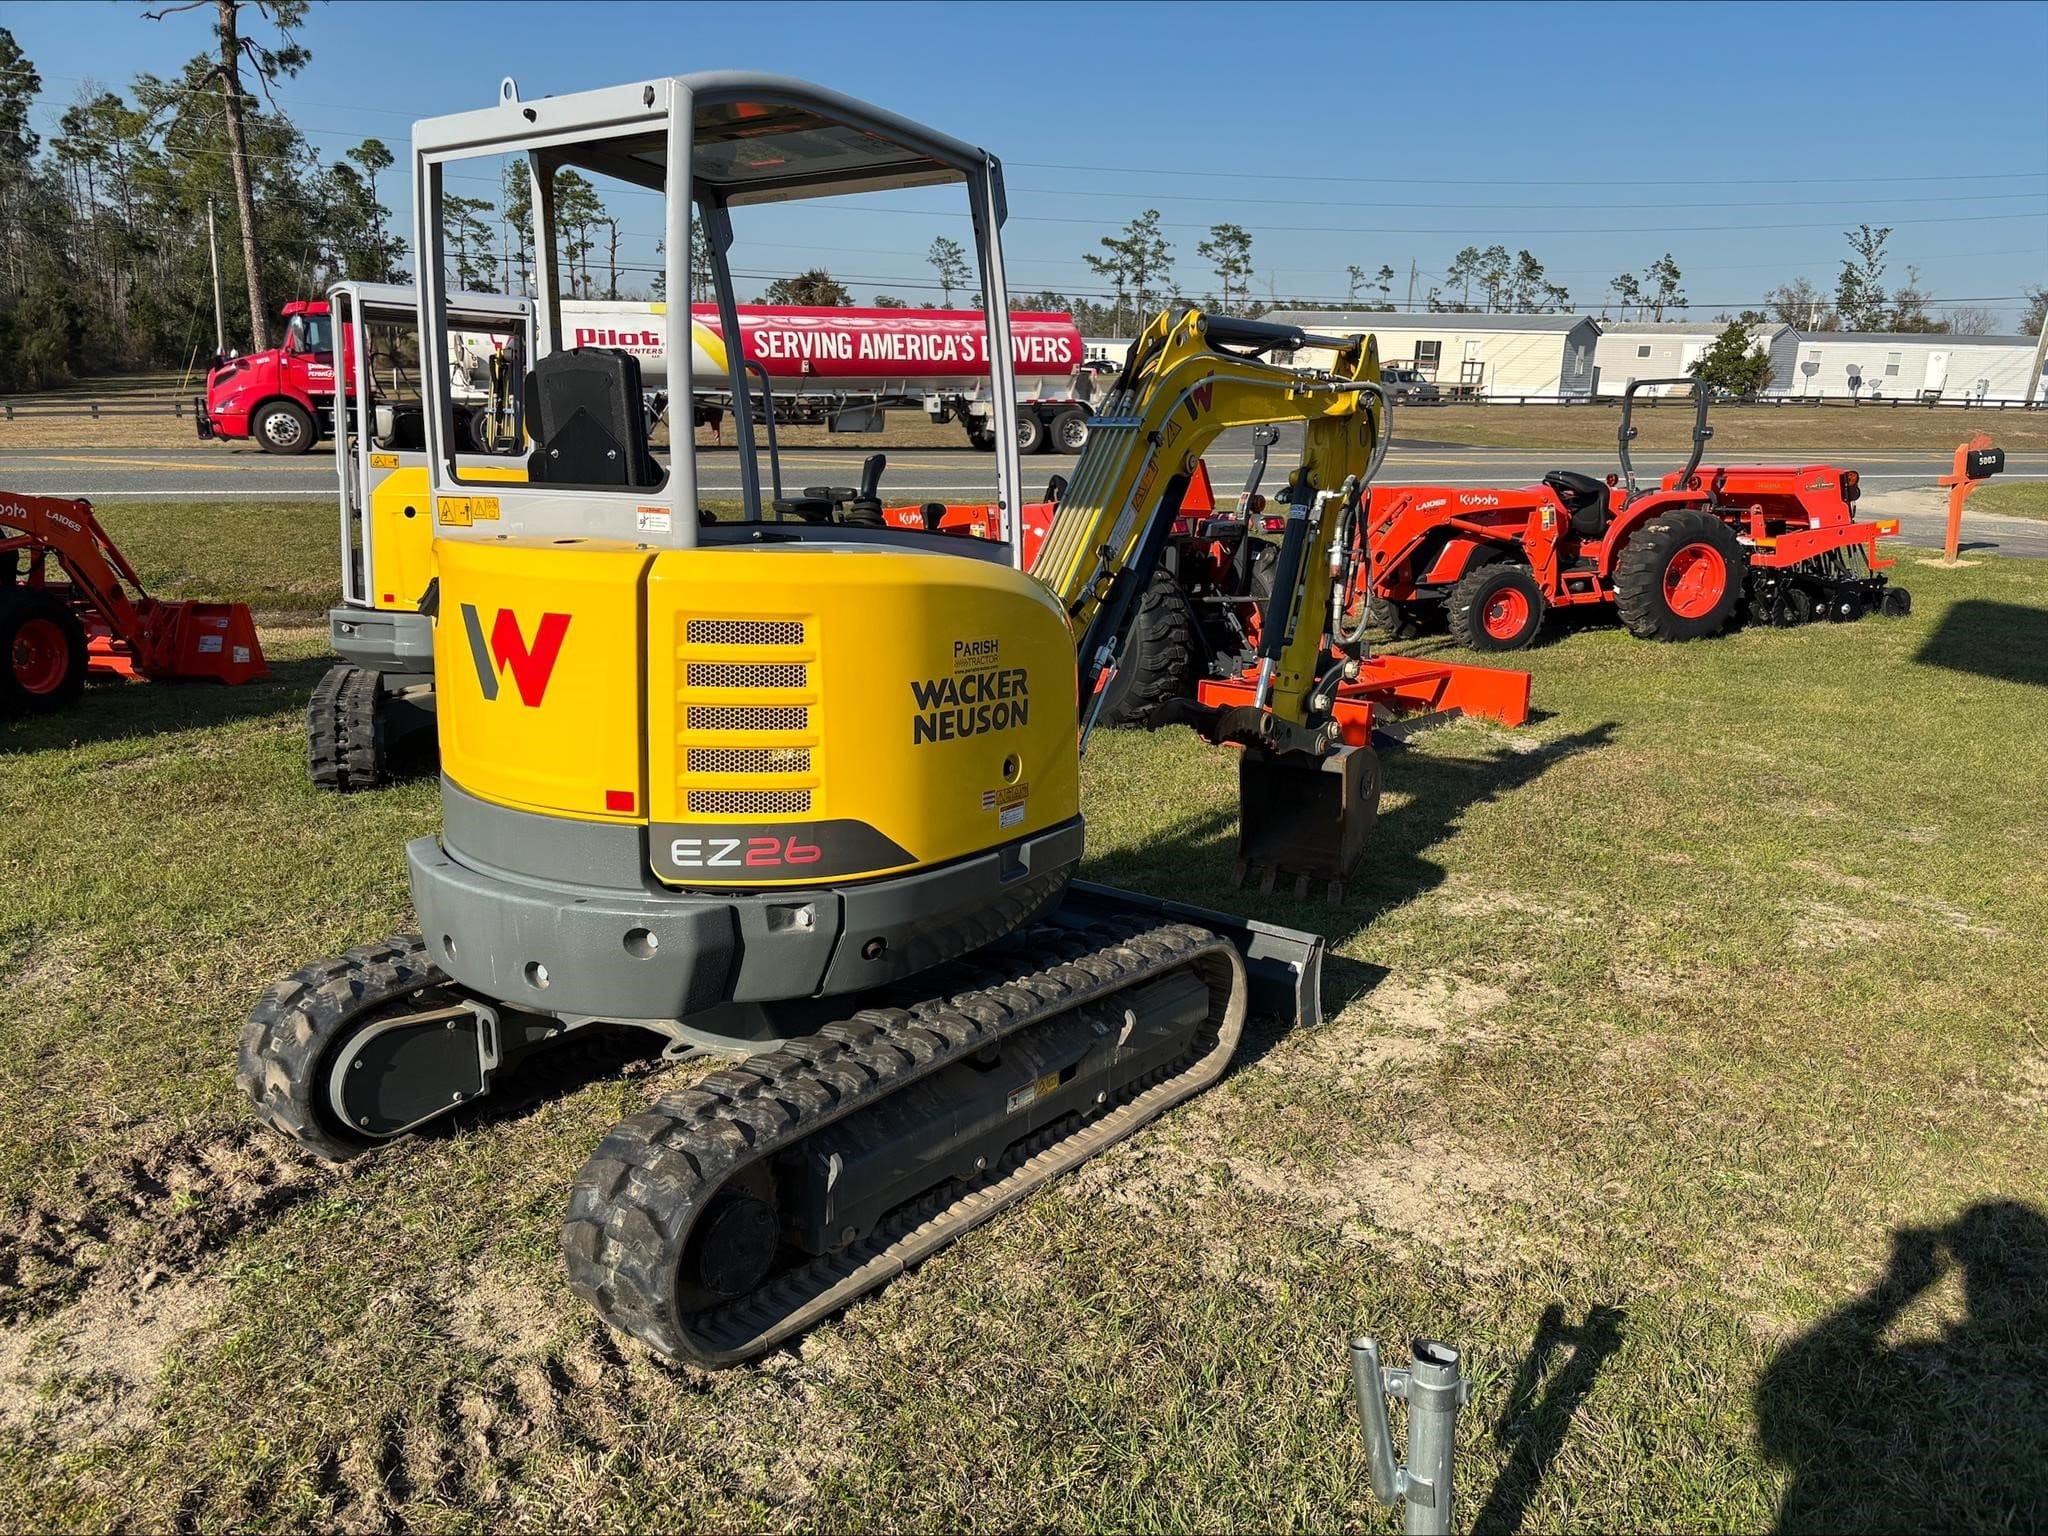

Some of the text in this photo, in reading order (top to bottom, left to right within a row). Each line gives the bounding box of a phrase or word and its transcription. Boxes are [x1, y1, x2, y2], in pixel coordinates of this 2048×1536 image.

[576, 328, 659, 348] Pilot
[753, 330, 852, 360] SERVING
[858, 332, 976, 362] AMERICA'S
[1979, 456, 1996, 465] 5003
[1460, 494, 1498, 505] Kubota
[954, 640, 998, 657] PARISH
[967, 654, 999, 667] TRACTOR
[911, 668, 1028, 711] WACKER
[914, 699, 1028, 744] NEUSON
[671, 836, 821, 866] EZ26
